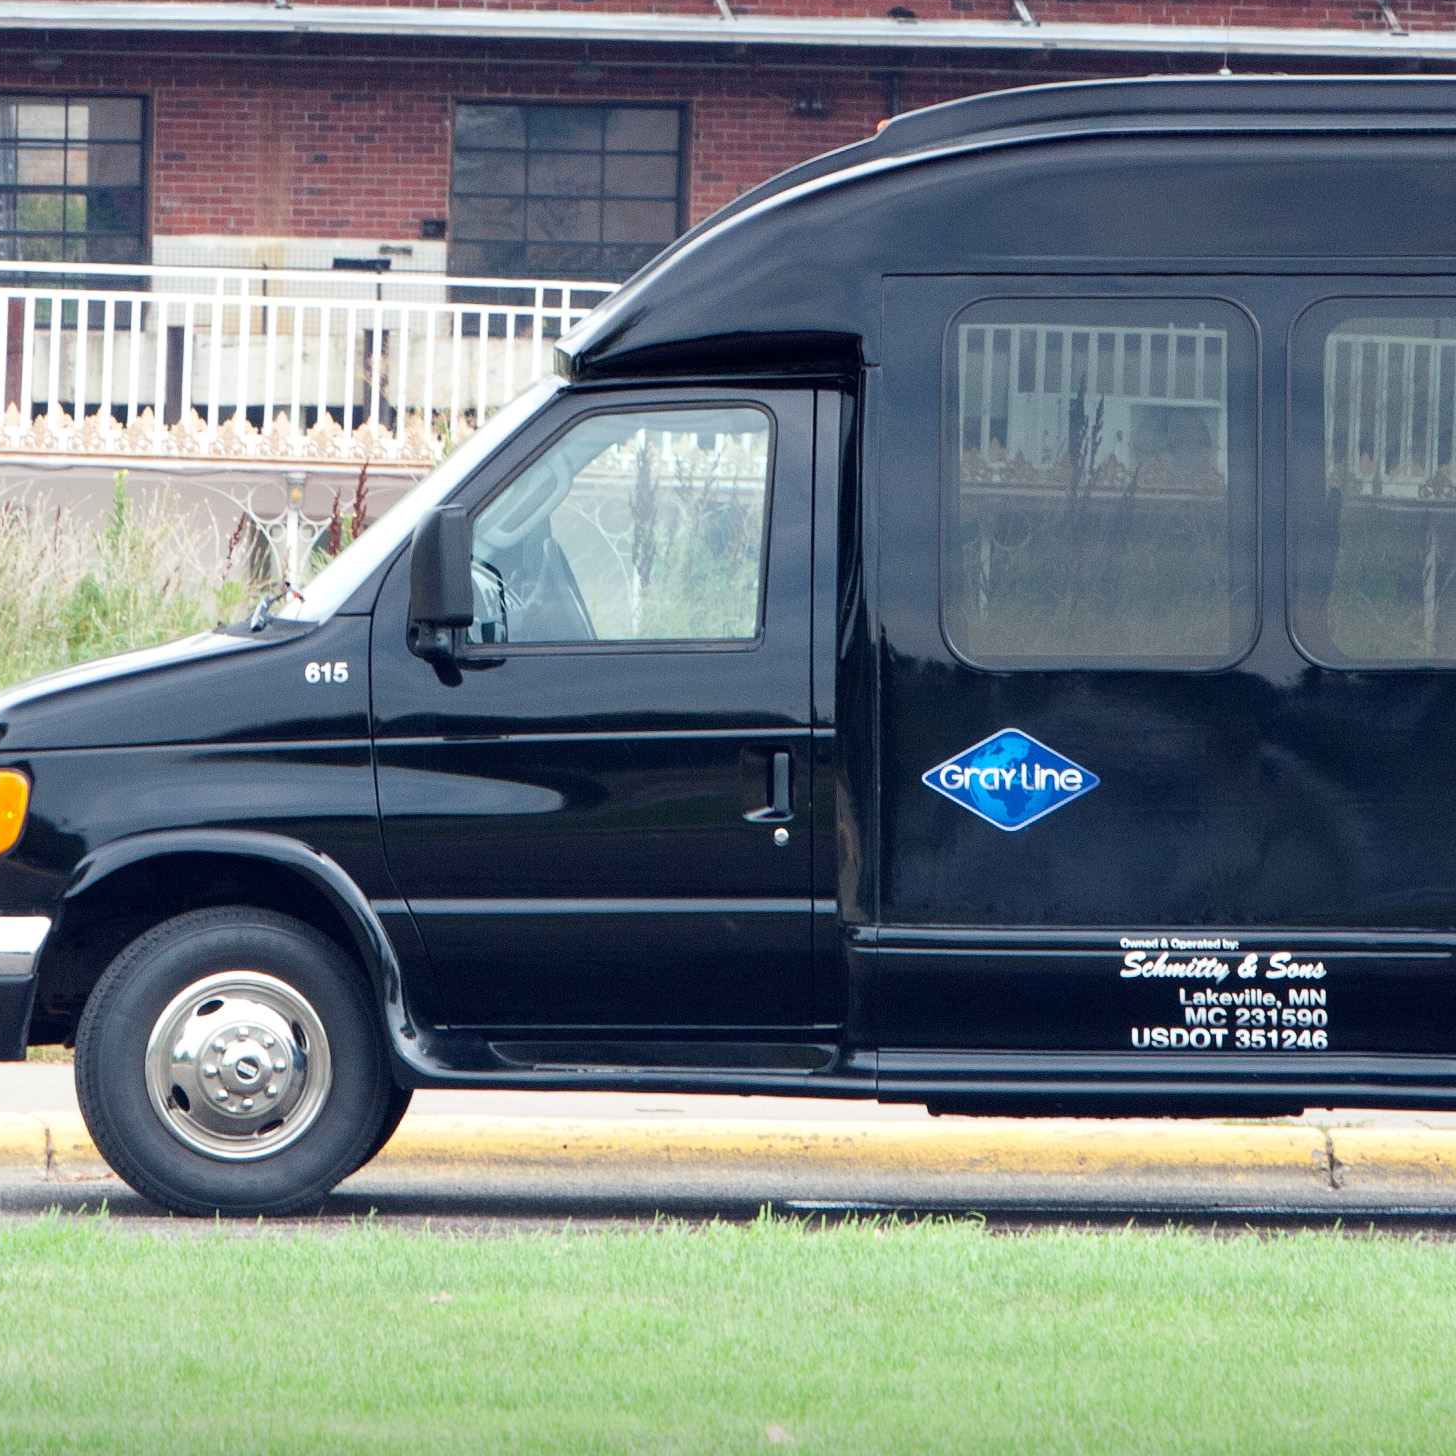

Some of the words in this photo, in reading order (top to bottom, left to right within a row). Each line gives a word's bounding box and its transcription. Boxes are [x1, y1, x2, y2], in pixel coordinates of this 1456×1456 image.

[304, 661, 349, 684] 615
[1120, 938, 1158, 949] Owned
[1160, 938, 1169, 949] &
[1171, 938, 1221, 950] Operated
[1120, 951, 1230, 985] Schmitty
[1238, 953, 1259, 979] &
[1266, 952, 1327, 980] Sons
[1179, 988, 1282, 1009] Lakeville,
[1289, 989, 1327, 1006] MN
[1185, 1007, 1227, 1026] MC
[1235, 1008, 1328, 1027] 231590
[1131, 1027, 1228, 1049] USDOT
[1235, 1029, 1328, 1049] 351246
